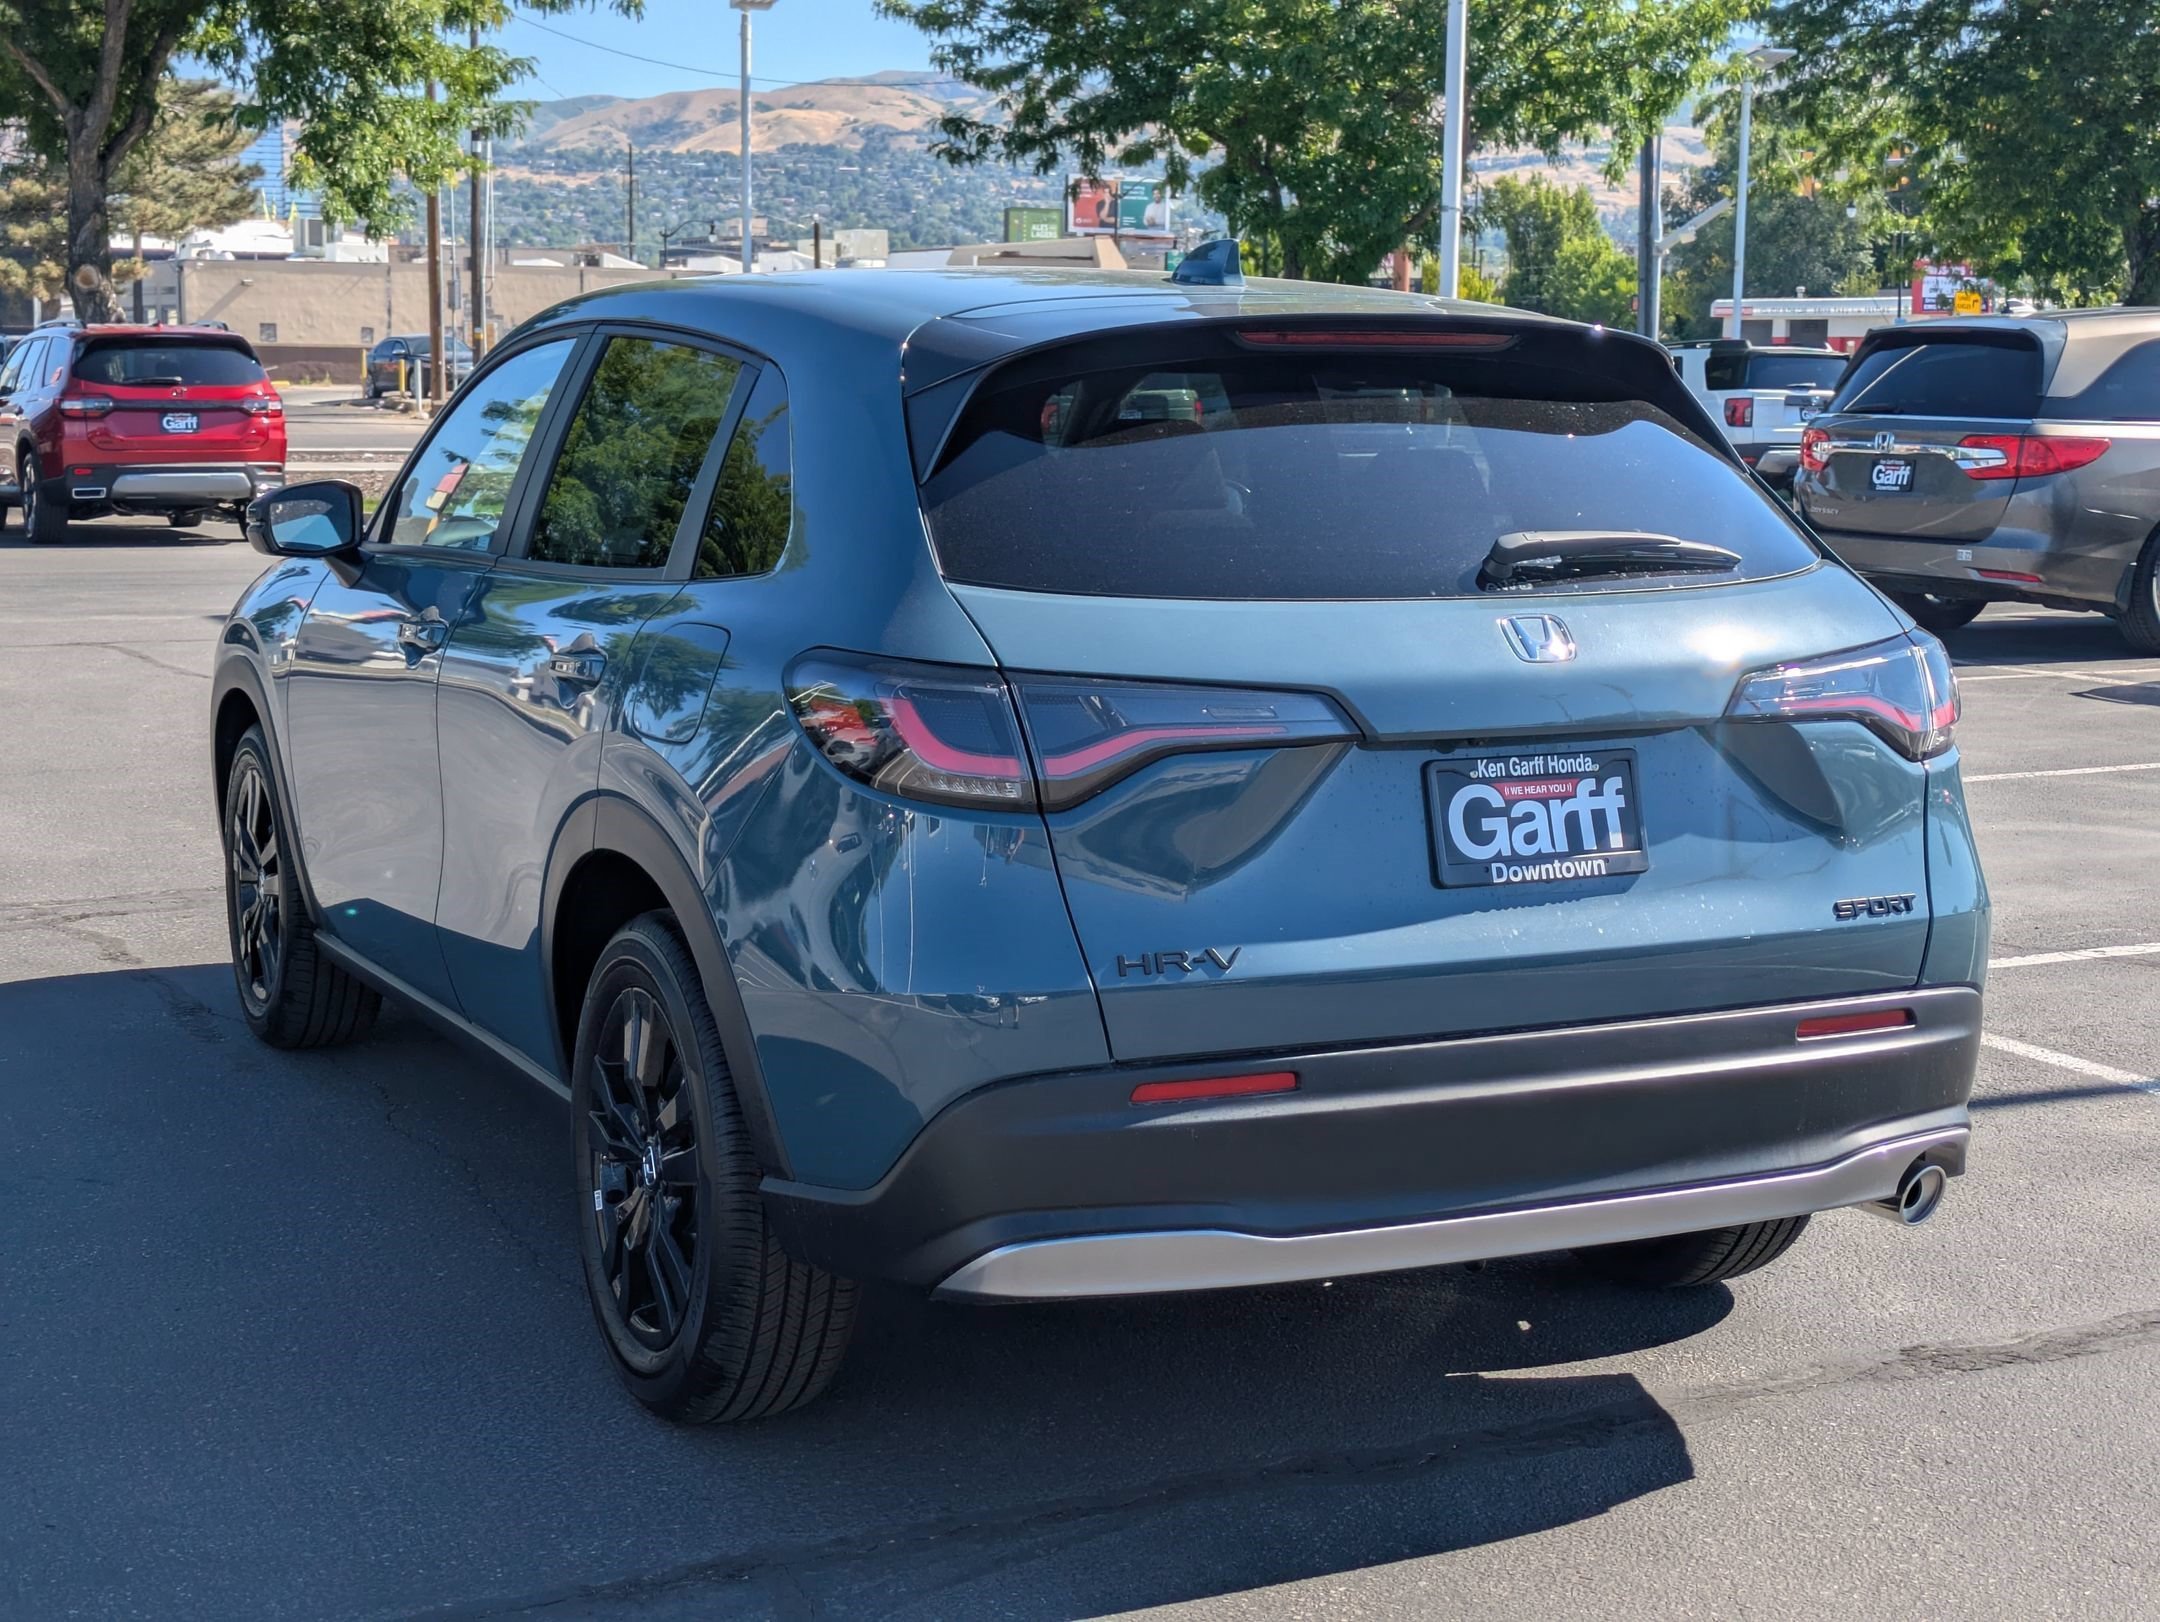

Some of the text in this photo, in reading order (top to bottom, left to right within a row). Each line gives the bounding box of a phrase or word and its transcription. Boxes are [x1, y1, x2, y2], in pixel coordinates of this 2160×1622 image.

[162, 416, 198, 430] Garff
[1872, 464, 1911, 486] Garff
[1477, 753, 1593, 778] Ken Garff Honda
[1510, 783, 1567, 796] WE HEAR YOU
[1448, 776, 1626, 860] Garff
[1490, 858, 1607, 884] Downtown
[1832, 892, 1917, 921] SPORT
[1116, 945, 1242, 977] HR-V
